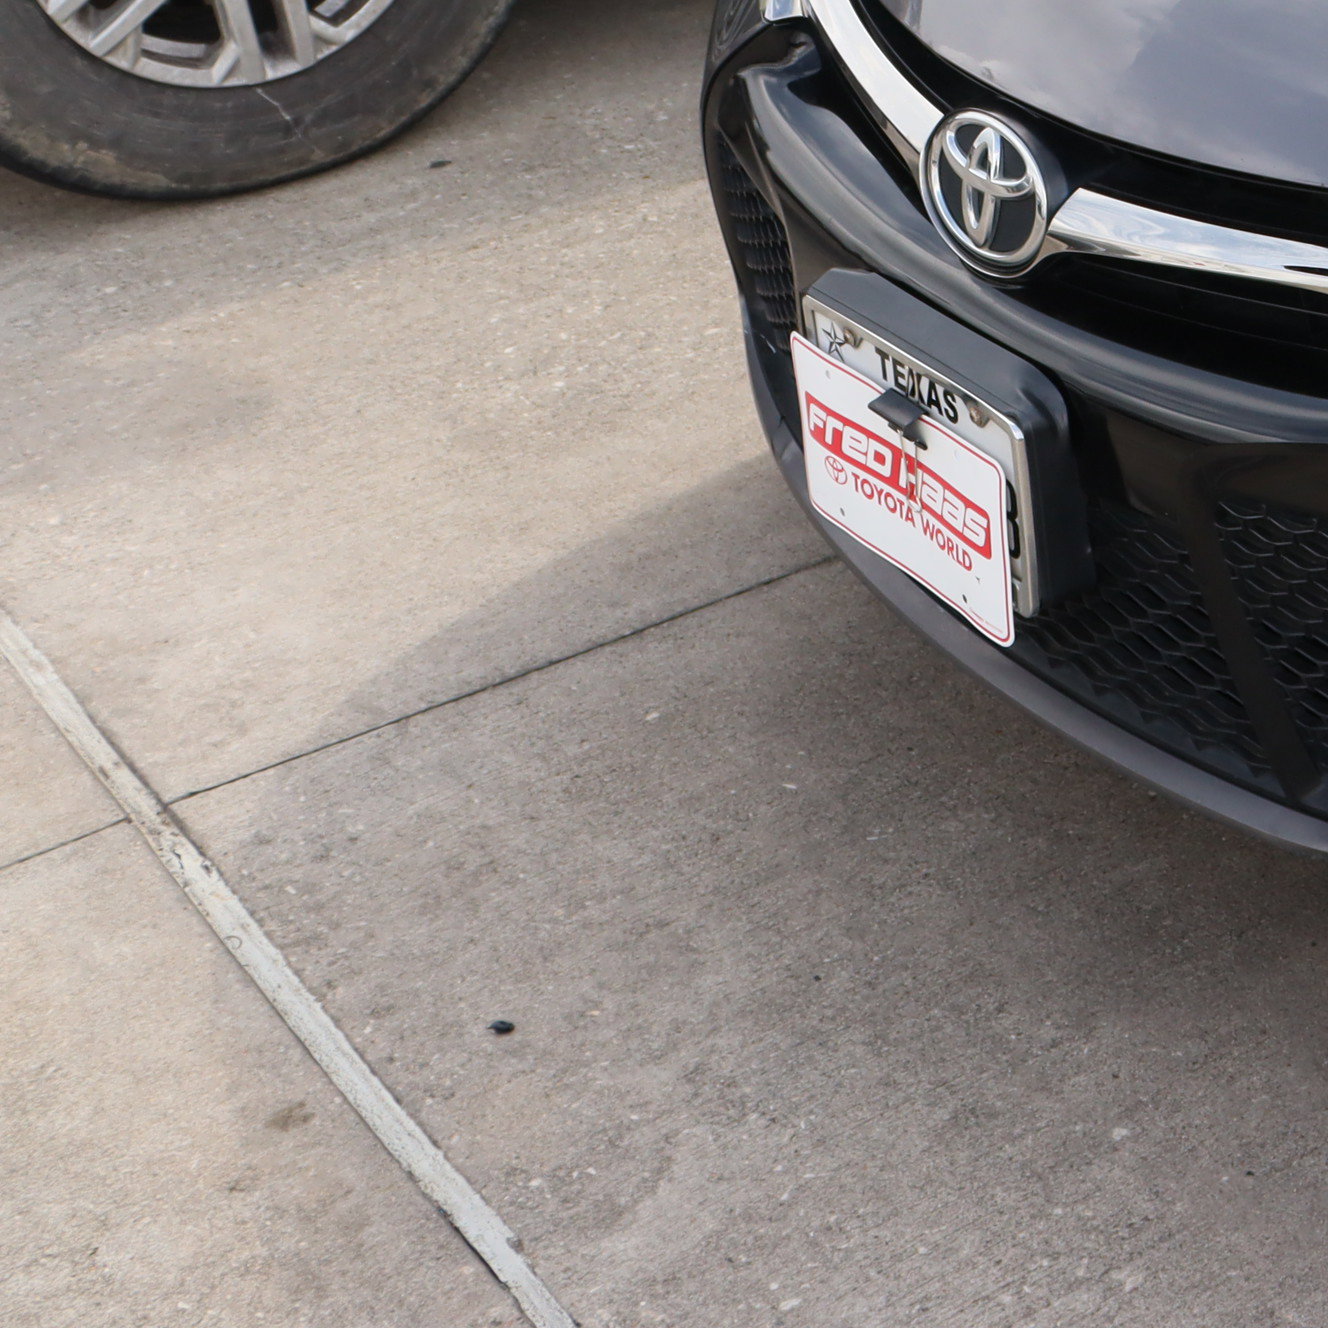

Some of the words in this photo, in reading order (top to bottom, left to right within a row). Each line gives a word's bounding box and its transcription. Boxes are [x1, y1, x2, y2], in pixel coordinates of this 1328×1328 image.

[874, 346, 959, 425] TEXAS
[851, 472, 916, 529] TOYOTA
[920, 514, 973, 572] WORLD
